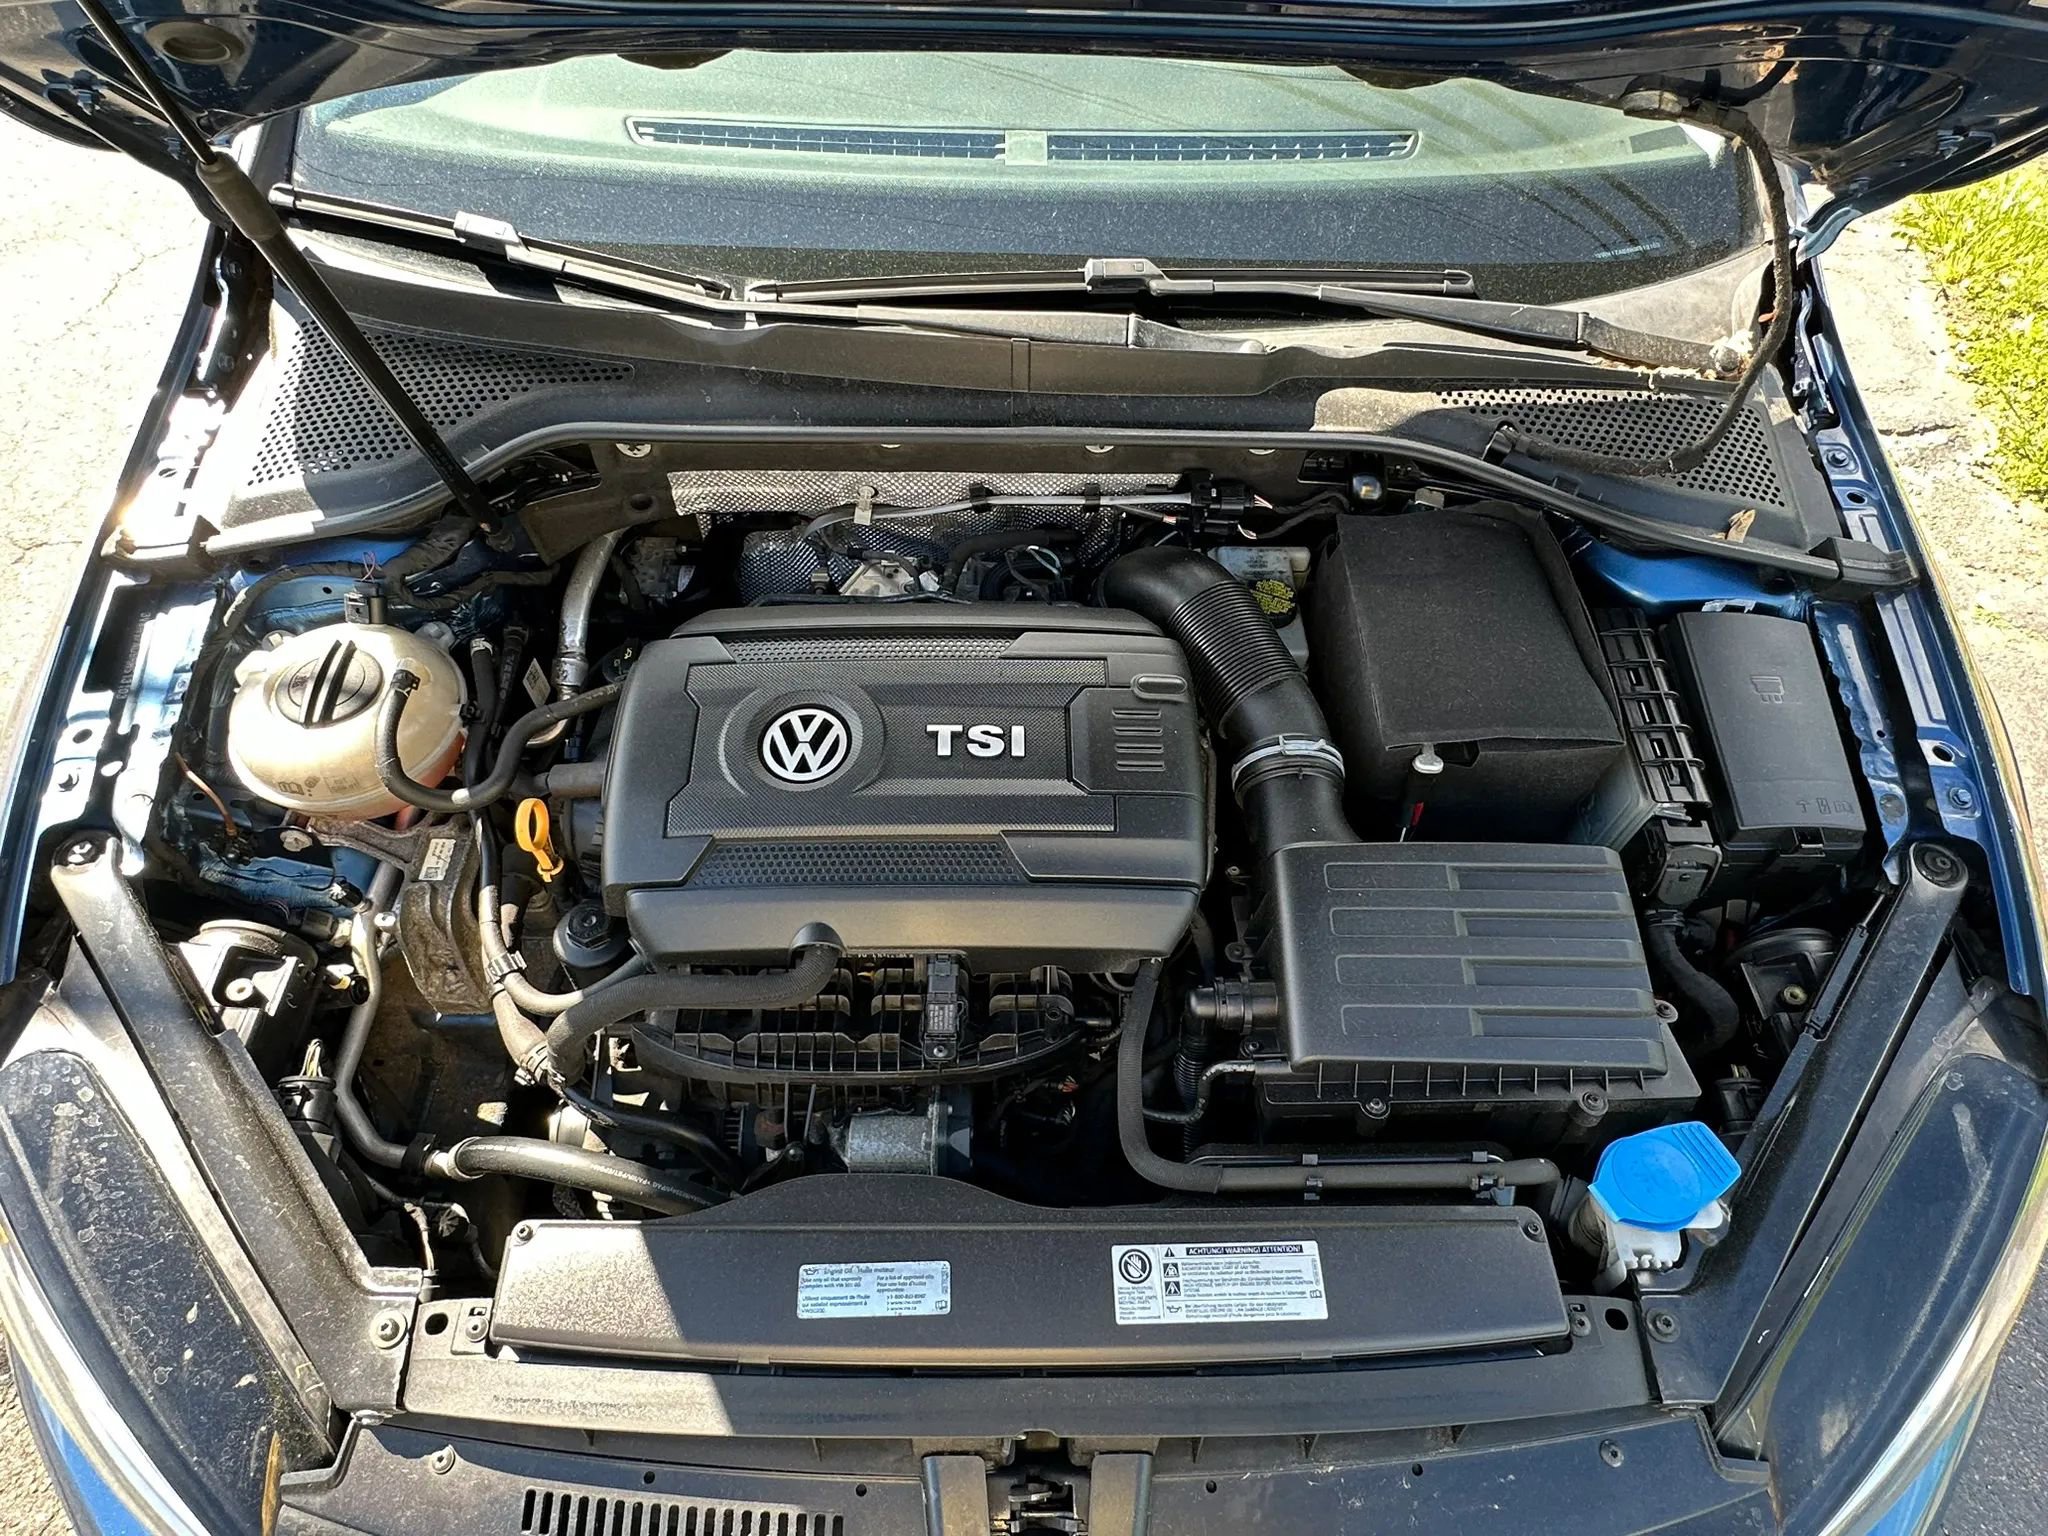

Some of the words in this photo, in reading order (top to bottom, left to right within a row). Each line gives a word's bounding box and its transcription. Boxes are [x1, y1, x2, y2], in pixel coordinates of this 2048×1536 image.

[763, 708, 847, 781] VW
[926, 724, 1025, 757] TSI
[1189, 1247, 1224, 1255] ACHTUNG!
[1225, 1246, 1260, 1254] WARNING!
[1262, 1245, 1301, 1253] ATTENTION!
